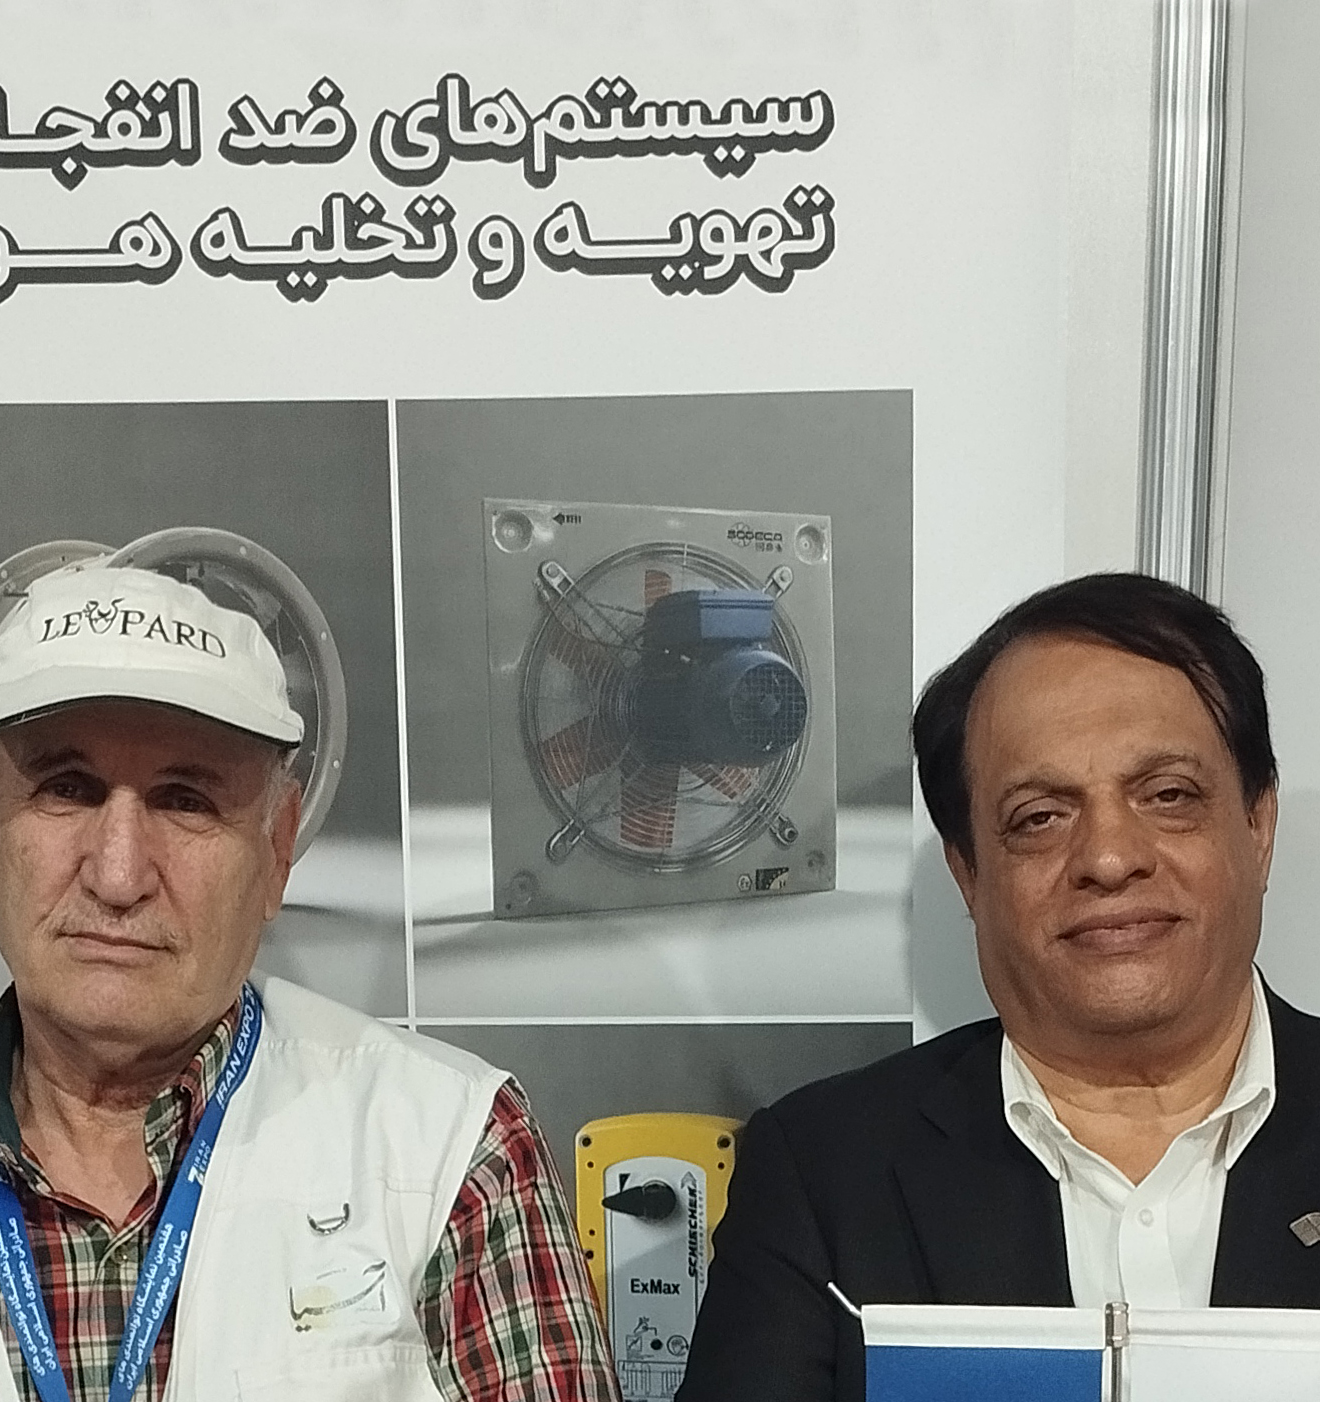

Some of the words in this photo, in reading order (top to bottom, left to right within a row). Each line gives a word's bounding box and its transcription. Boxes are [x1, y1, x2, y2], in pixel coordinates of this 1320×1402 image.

[217, 76, 357, 167] ضد
[190, 191, 457, 301] تخلیه
[471, 214, 525, 299] و
[534, 183, 835, 295] تهویه
[216, 1053, 241, 1110] IRAN
[235, 1003, 255, 1058] EXPO
[194, 1139, 208, 1167] IRAN
[8, 1217, 26, 1259] صادراتی
[154, 1223, 174, 1265] هفتمین
[167, 1230, 188, 1277] صادراتی
[18, 1260, 37, 1301] جمهوری
[135, 1263, 159, 1315] نمایشگاه
[151, 1276, 173, 1320] جمهوری
[289, 1260, 387, 1332] آسیا
[630, 1278, 681, 1296] ExMax
[26, 1301, 49, 1346] اسلامی
[135, 1317, 155, 1366] اسلامی
[40, 1345, 57, 1370] ایران
[126, 1362, 138, 1390] ایران
